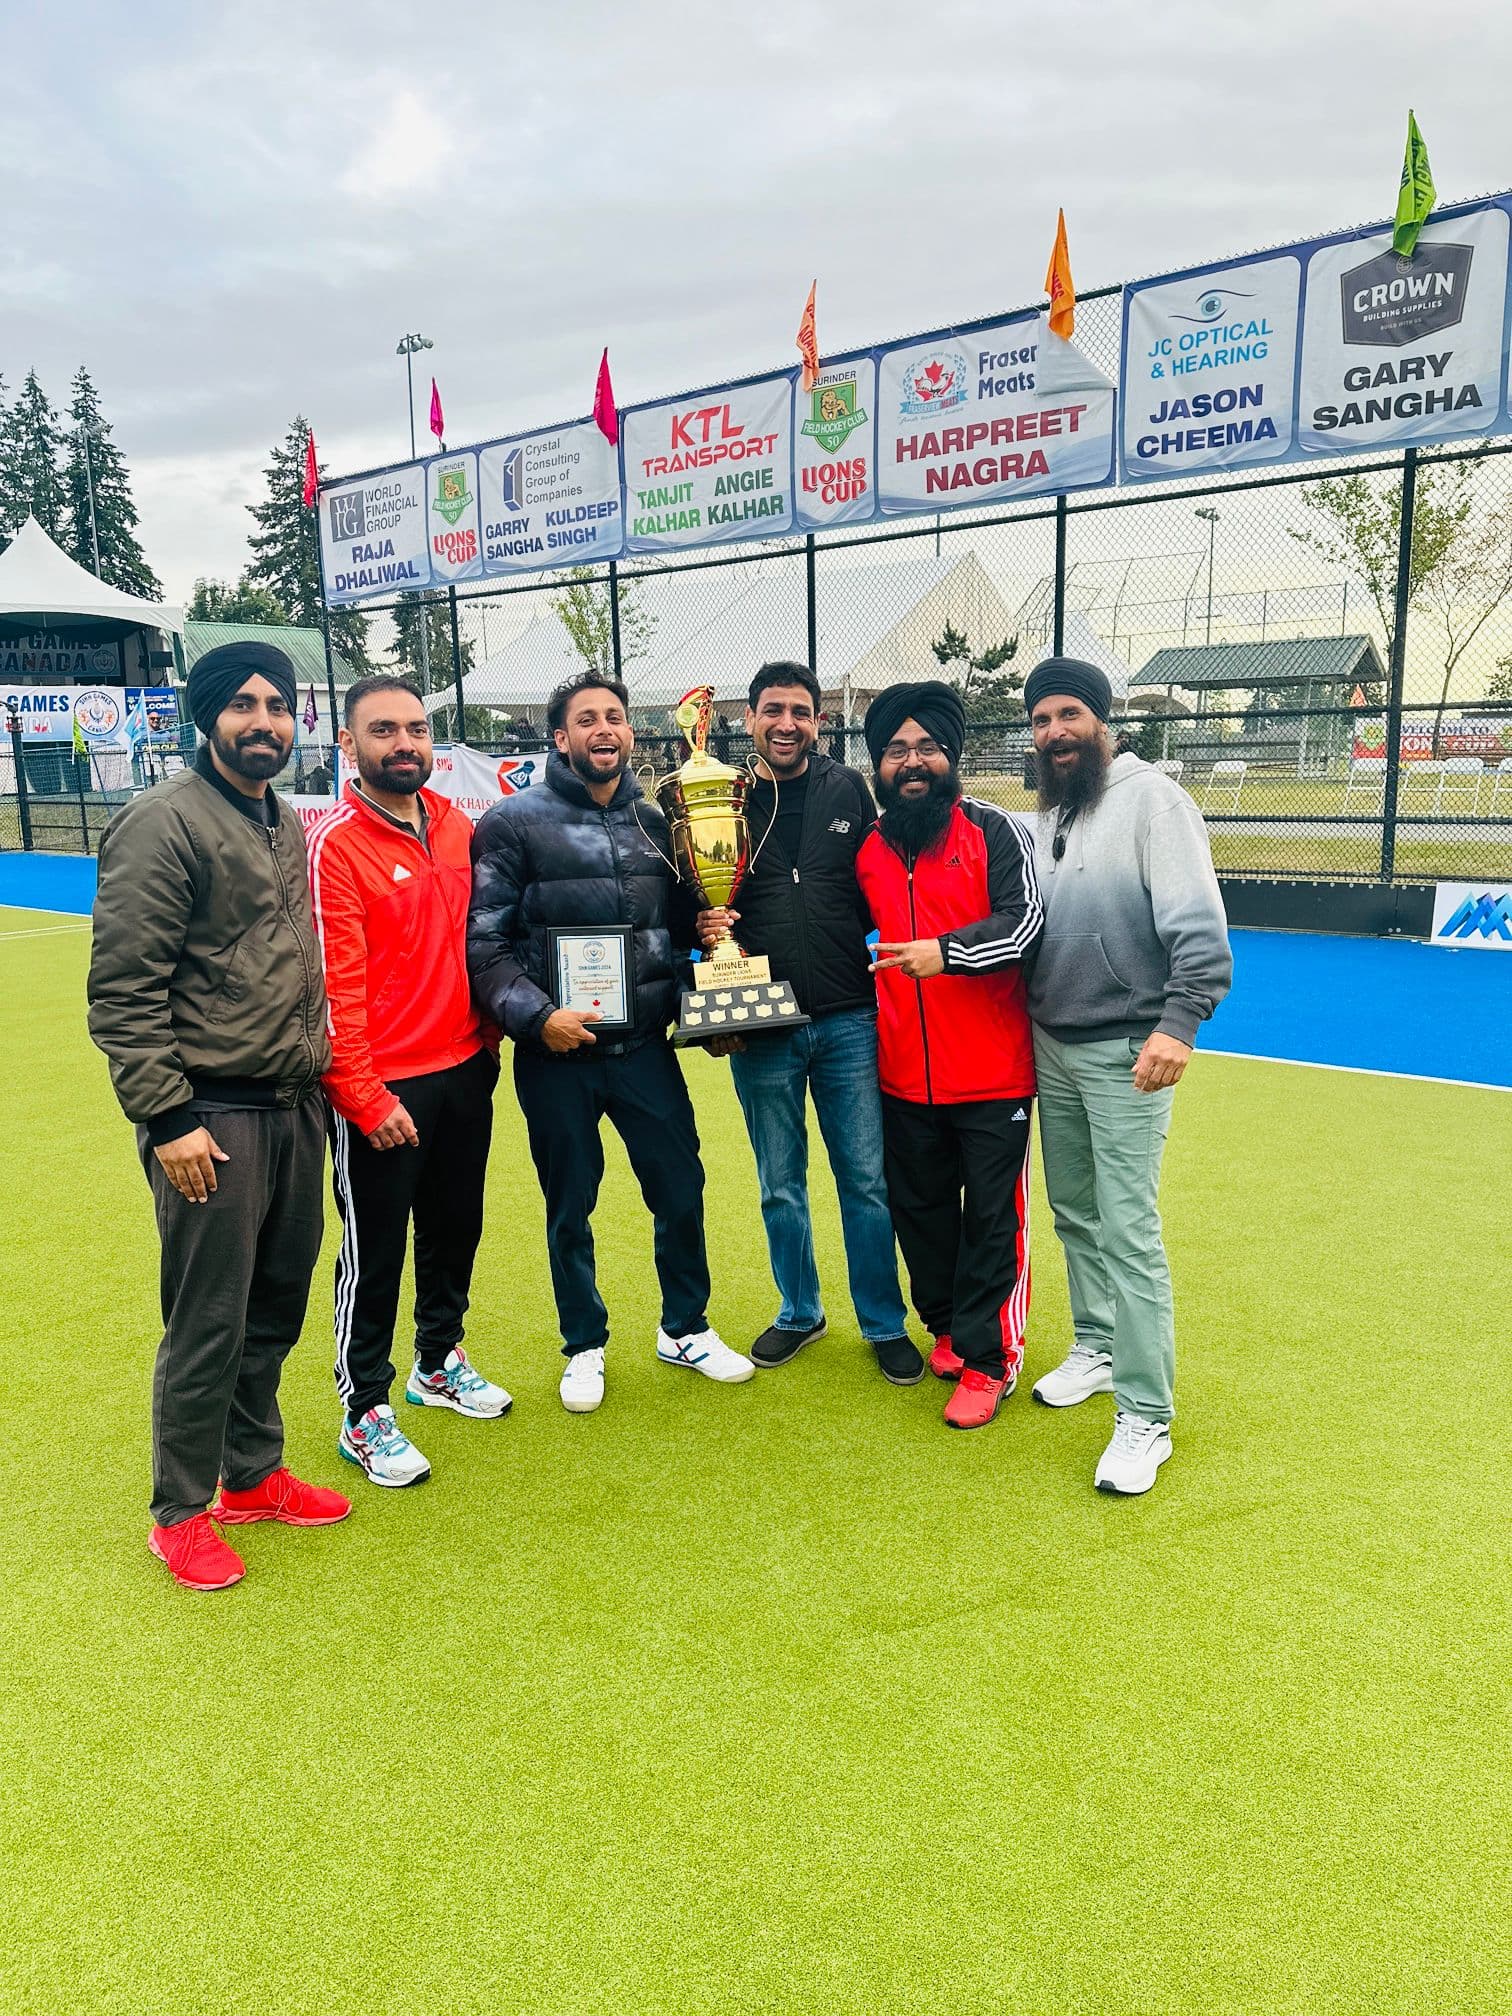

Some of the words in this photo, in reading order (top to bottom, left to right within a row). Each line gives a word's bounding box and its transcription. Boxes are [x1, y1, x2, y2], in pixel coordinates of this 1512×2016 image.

[1353, 272, 1454, 313] CROWN
[1363, 308, 1400, 322] BUILDING
[1402, 300, 1442, 314] SUPPLIES
[1148, 337, 1172, 358] JC
[1179, 318, 1274, 352] OPTICAL
[978, 344, 1040, 375] Fraser
[1151, 361, 1165, 379] &
[1172, 341, 1268, 377] HEARING
[1344, 351, 1454, 392] GARY
[811, 370, 857, 387] SURINDER
[978, 371, 1036, 400] Meats
[1150, 383, 1264, 424] JASON
[1312, 383, 1483, 432] SANGHA
[671, 404, 745, 450] KTL
[804, 422, 820, 434] FIELD
[820, 421, 847, 433] HOCKEY
[847, 411, 865, 427] CLUB
[896, 404, 1088, 463] HARPREET
[1136, 416, 1279, 459] CHEEMA
[525, 438, 561, 456] Crystal
[642, 433, 779, 478] TRANSPORT
[827, 435, 840, 448] 50
[525, 452, 580, 473] Consulting
[801, 457, 867, 493] LIONS
[926, 449, 1050, 494] NAGRA
[365, 483, 402, 503] WORLD
[525, 471, 557, 490] Group
[559, 468, 571, 481] of
[637, 482, 694, 510] TANJIT
[714, 467, 774, 497] ANGIE
[821, 478, 867, 505] CUP
[365, 495, 418, 518] FINANCIAL
[525, 484, 583, 506] Companies
[366, 514, 401, 533] GROUP
[485, 518, 530, 540] GARRY
[545, 501, 619, 527] KULDEEP
[633, 508, 701, 537] KALHAR
[707, 494, 785, 526] KALHAR
[352, 539, 395, 564] RAJA
[433, 528, 477, 556] LIONS
[447, 545, 477, 564] CUP
[487, 537, 544, 560] SANGHA
[547, 527, 597, 549] SINGH
[335, 560, 420, 592] DHALIWAL
[7, 695, 70, 713] GAMES
[712, 960, 749, 972] WINNER
